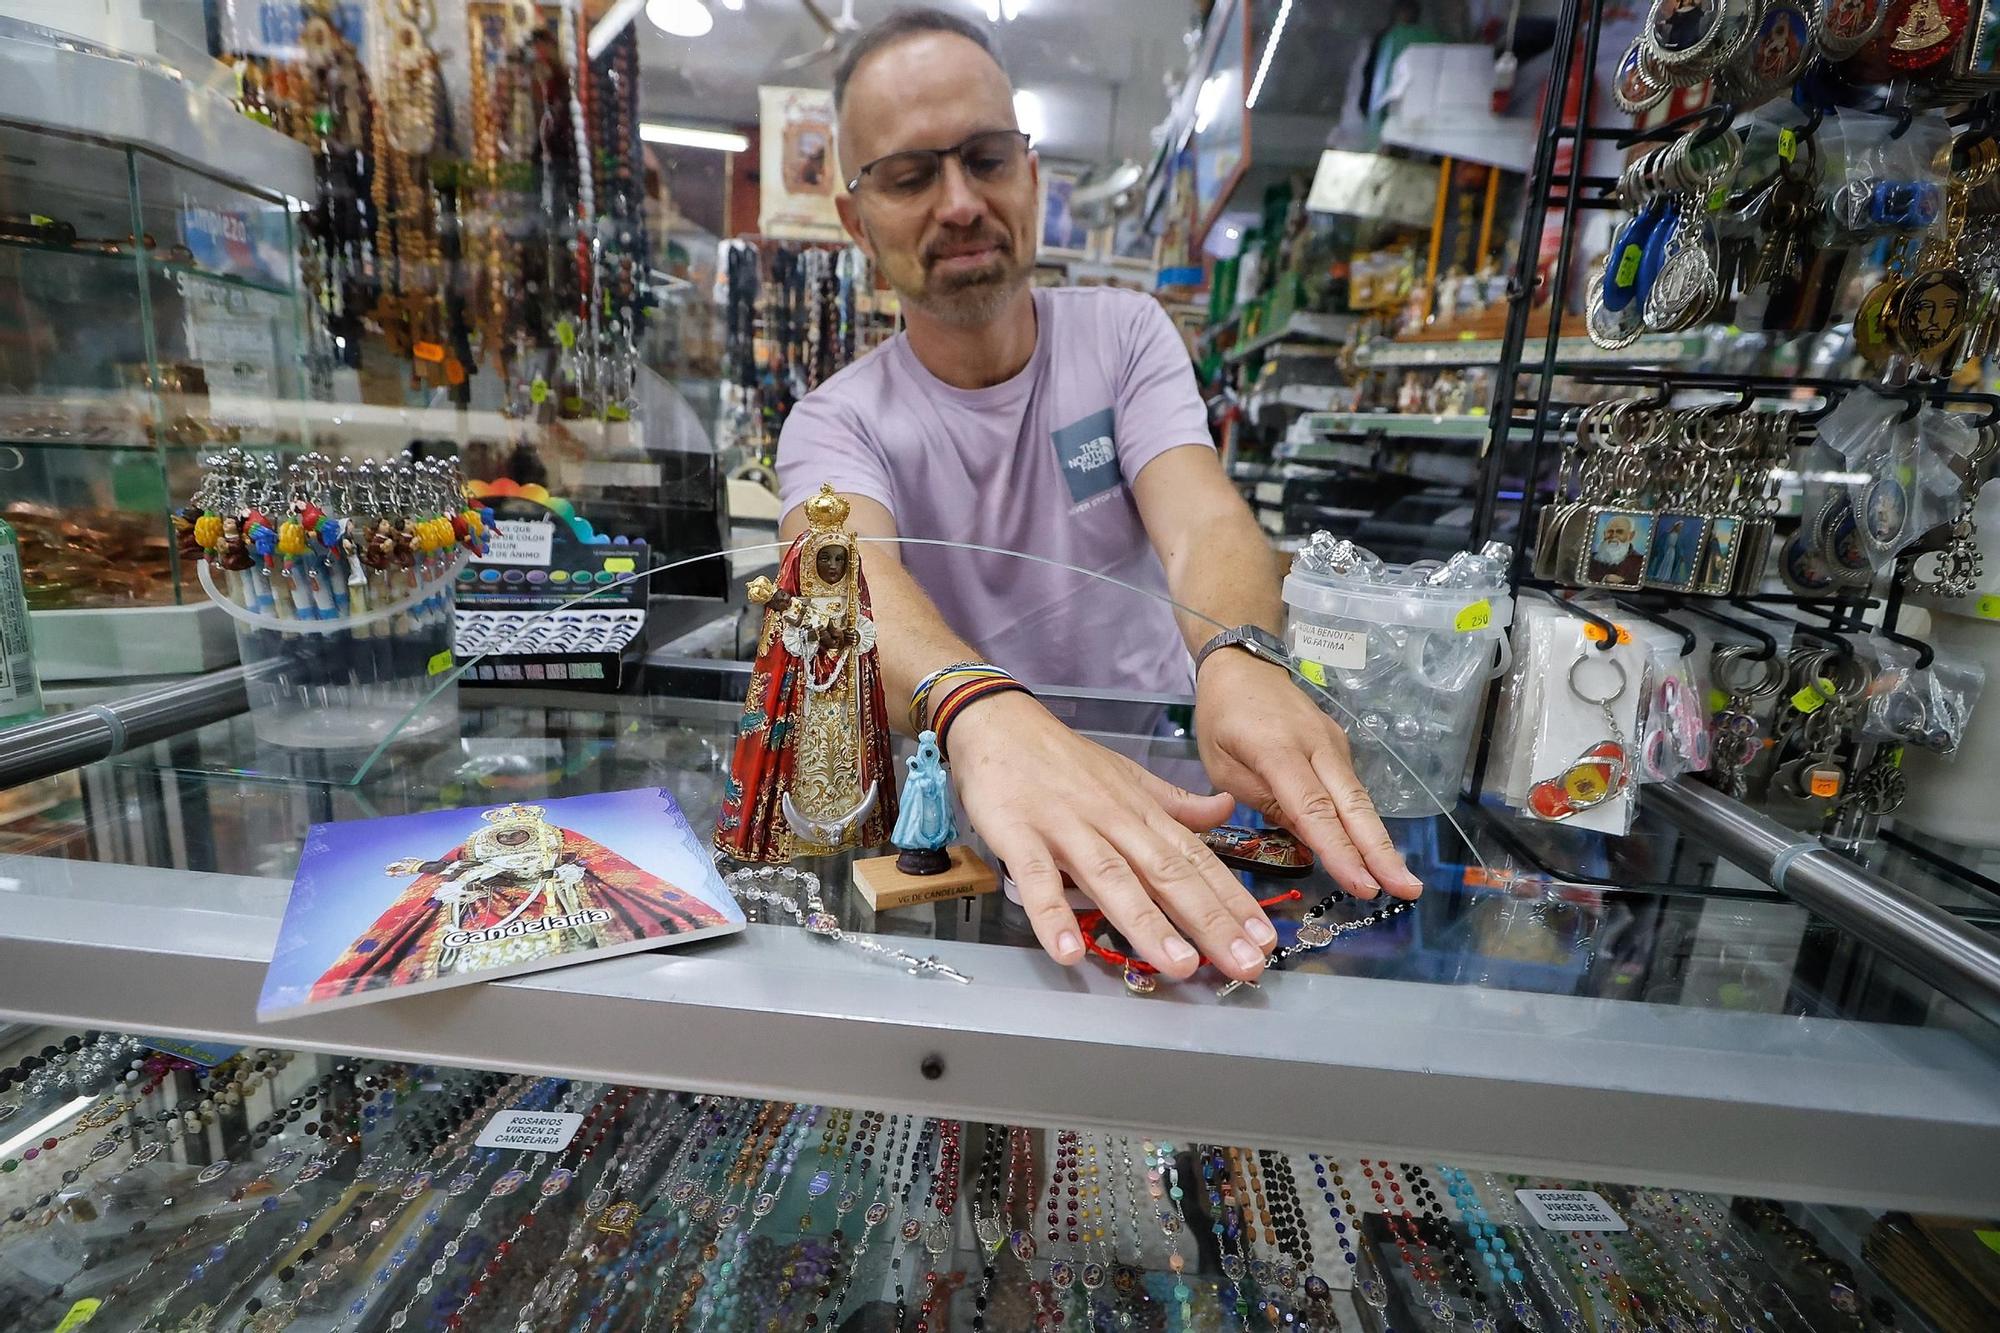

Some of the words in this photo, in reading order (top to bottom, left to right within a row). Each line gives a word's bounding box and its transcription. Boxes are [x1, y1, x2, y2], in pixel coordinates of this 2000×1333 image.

[1080, 438, 1100, 454] THE
[1068, 447, 1105, 469] NORTH
[1081, 456, 1107, 473] FACE
[512, 525, 531, 533] QUE
[516, 533, 545, 542] COLOR
[1471, 612, 1488, 627] 250
[1317, 628, 1355, 641] BENDITA
[897, 895, 911, 905] VG
[924, 883, 975, 900] CANDELARIA
[441, 908, 612, 949] Candelaria
[510, 1116, 564, 1127] ROSARIOS
[505, 1125, 545, 1135] VIRGEN
[546, 1127, 562, 1136] DE
[494, 1134, 559, 1145] CANDELARIA
[1535, 1192, 1588, 1202] ROSARIOS
[1543, 1202, 1584, 1212] VIRGEN
[1583, 1203, 1600, 1212] DE
[1546, 1212, 1612, 1223] CANDELARIA
